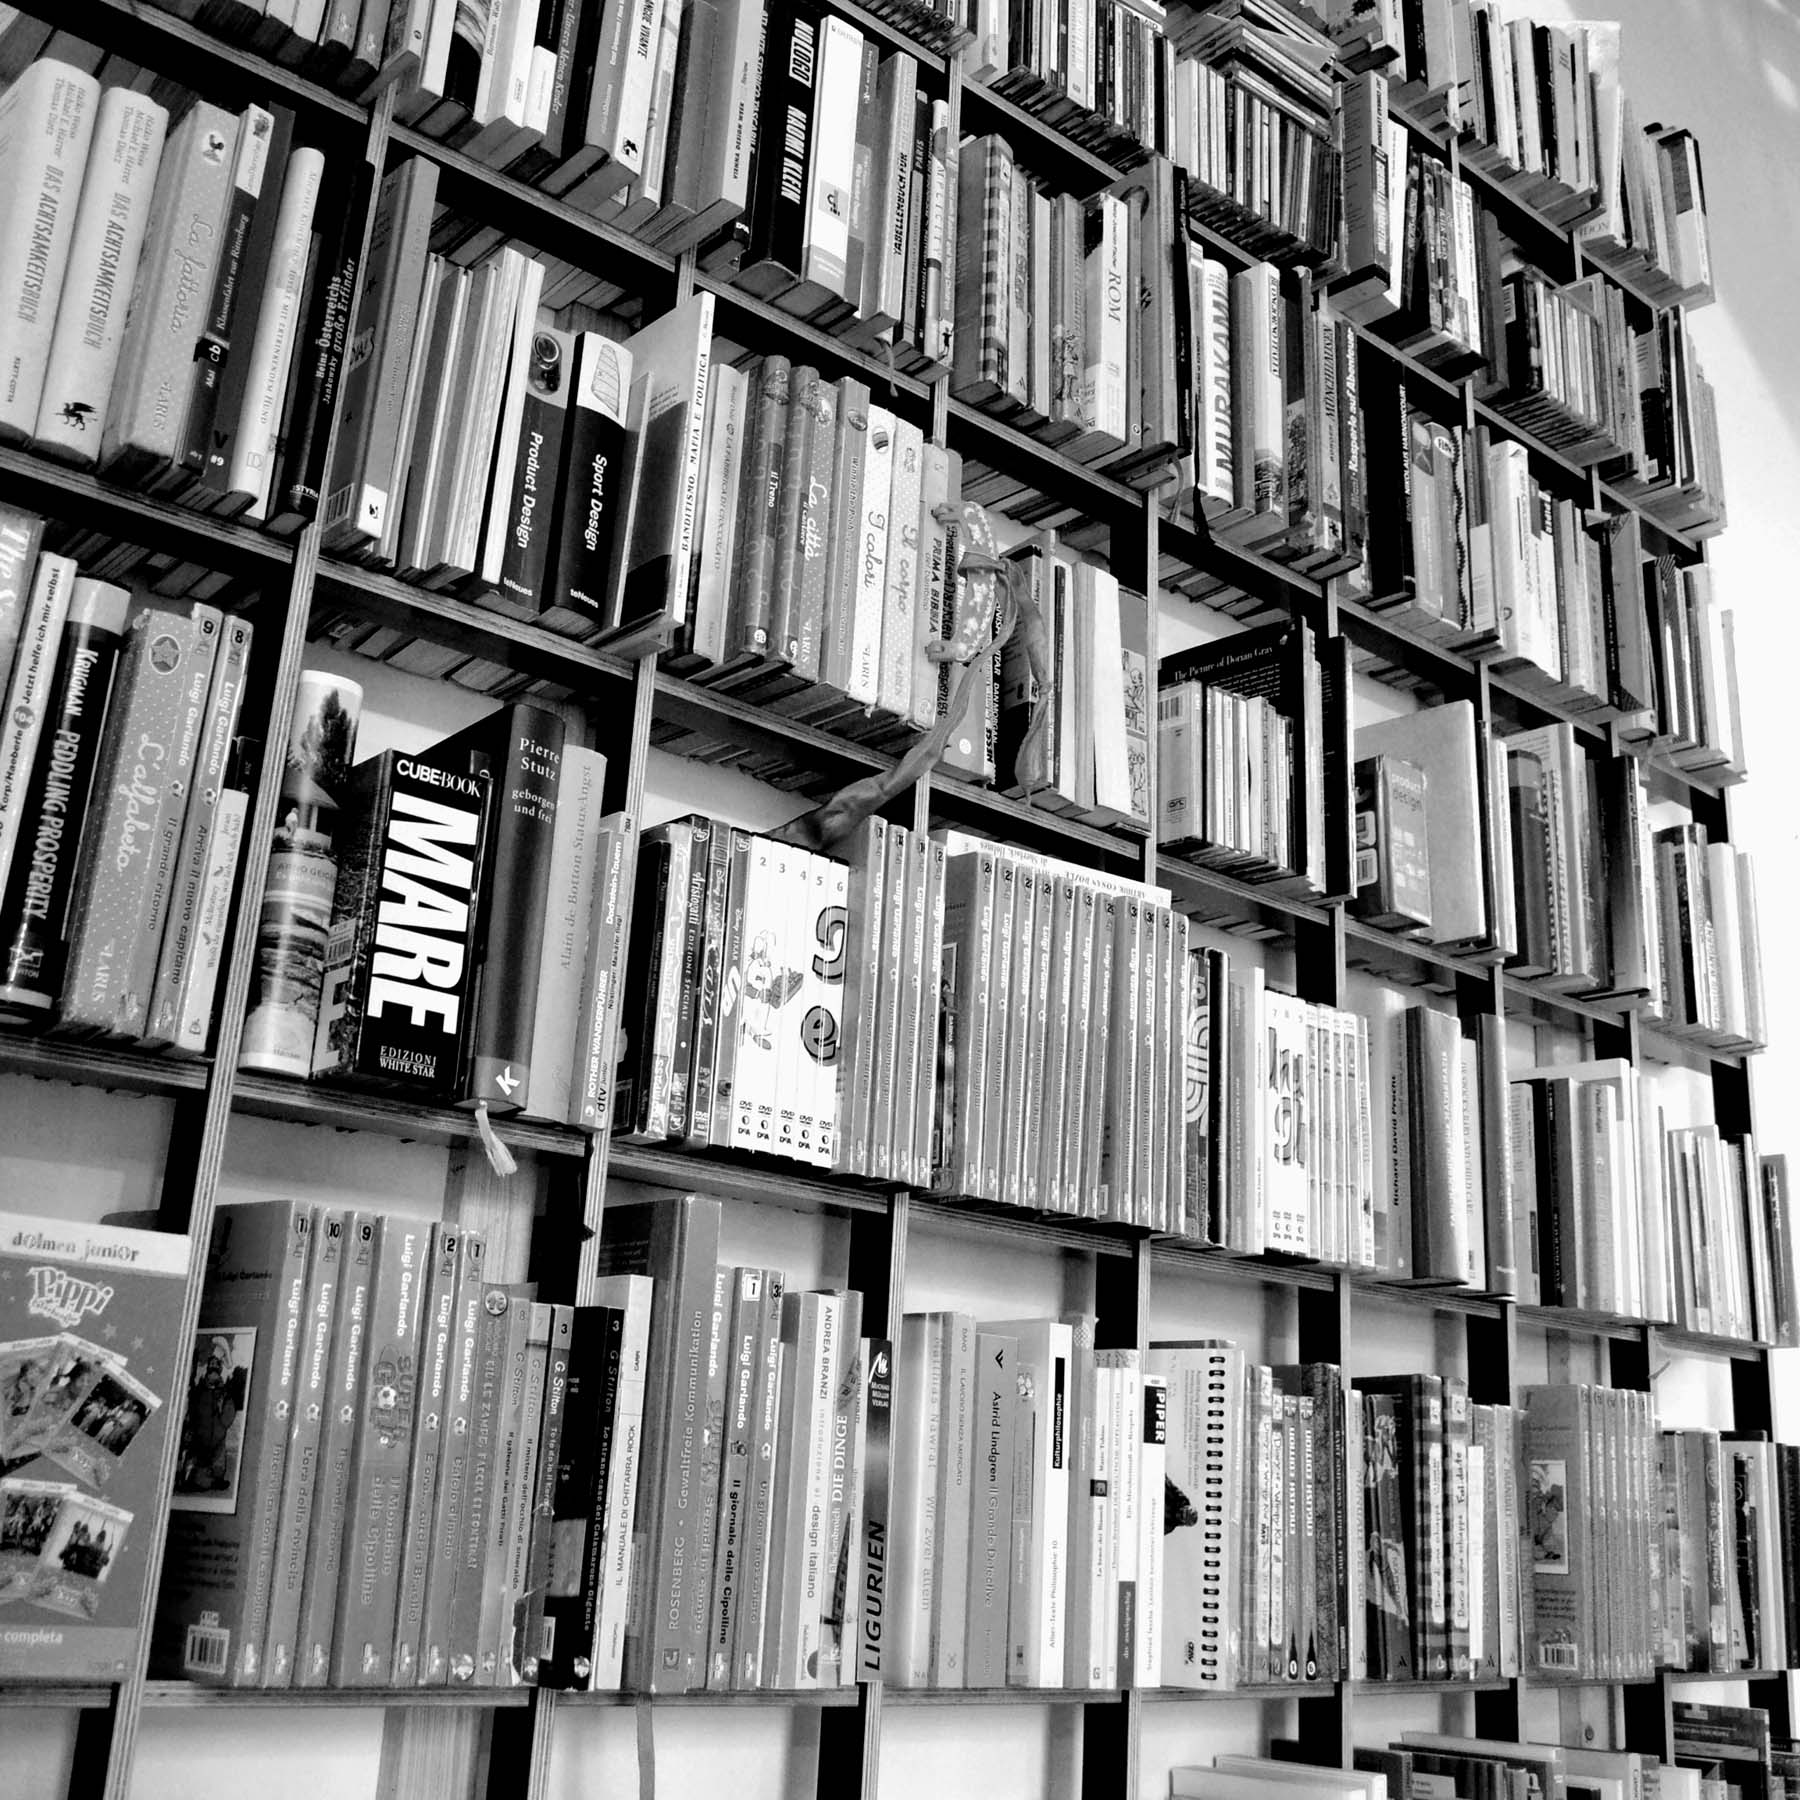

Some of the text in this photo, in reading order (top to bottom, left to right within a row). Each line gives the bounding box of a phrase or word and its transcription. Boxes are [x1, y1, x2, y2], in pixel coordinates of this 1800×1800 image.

[789, 18, 814, 88] NO LOGO
[781, 105, 807, 205] NAOMI KLEIN
[915, 140, 924, 171] PARIS
[894, 152, 908, 255] TABELLENBUCH FÜR
[18, 165, 64, 325] DAS ACHTSAMKEITSBUCH
[83, 192, 131, 350] DAS ACHTSAMKEITSBUCH
[169, 214, 214, 335] La fattoria
[216, 214, 249, 330] Klassenfahrt zur Ritterburg
[1108, 271, 1123, 322] ROM
[316, 274, 343, 378] Heinz Österreichs
[322, 256, 356, 404] Jankowsky große Erfinder
[1212, 289, 1232, 469] MURAKAMI
[1347, 326, 1358, 473] Kasperle auf Abenteuer
[682, 353, 707, 552] BANDITISMO, MAFIA E POLITICA
[1399, 384, 1412, 494] NIKOLAUS HARNONCOURT
[516, 431, 544, 549] Product Design
[585, 453, 608, 551] Sport Design
[768, 481, 778, 508] Treno
[804, 476, 828, 561] La città
[864, 532, 882, 588] colori
[891, 559, 910, 613] corpo
[929, 539, 942, 633] PRIMA BIBBIA
[22, 568, 60, 704] Jetzt helfe ich mir selbst
[203, 619, 214, 637] 9
[234, 628, 245, 646] 8
[1174, 669, 1187, 681] The
[1188, 662, 1215, 677] Picture
[1254, 645, 1274, 662] Gray
[217, 680, 235, 720] Luigi
[208, 722, 229, 775] Garlando
[519, 737, 561, 763] Pierre
[520, 757, 557, 781] Stutz
[26, 649, 98, 920] KRUGMAN PEDDLING PROSPERITY
[117, 733, 165, 873] L'alfabeto
[512, 787, 556, 810] geborgen
[513, 803, 553, 824] und frei
[190, 824, 208, 865] Arriva
[759, 856, 767, 867] 2
[778, 863, 785, 874] 3
[605, 840, 622, 926] Dachstein-Tauern
[800, 870, 807, 881] 4
[816, 875, 823, 886] 5
[837, 881, 843, 892] 6
[180, 879, 196, 923] nuovo
[366, 790, 479, 1035] MARE
[171, 925, 191, 986] capitano
[679, 871, 706, 1020] Aristogatti EDIZIONE SPECIALE
[380, 1045, 437, 1066] EDIZIONI
[587, 969, 610, 1099] ROTHER WANDERFÜHRER
[379, 1056, 436, 1078] WHITE STAR
[327, 1221, 341, 1239] 10
[362, 1225, 371, 1242] 9
[446, 1236, 456, 1252] 2
[473, 1243, 481, 1259] 1
[27, 1266, 114, 1317] Pippi
[319, 1283, 333, 1318] Luigi
[397, 1233, 416, 1337] Luigi Garlando
[750, 1282, 757, 1297] 1
[560, 1323, 568, 1335] 3
[612, 1319, 620, 1332] 3
[823, 1306, 833, 1353] ANDREA
[310, 1321, 328, 1389] Garlando
[609, 1349, 619, 1359] G
[819, 1355, 830, 1400] BRANZI
[603, 1366, 617, 1413] Stilton
[990, 1391, 1001, 1427] Astrid
[928, 1412, 938, 1469] Nawrat
[1053, 1392, 1063, 1468] Kulturphilosophie
[1155, 1392, 1166, 1442] PIPER
[598, 1442, 609, 1475] strano
[669, 1310, 703, 1631] ROSENBERG Gewaltfreie Kommunikation
[988, 1429, 1000, 1483] Lindgren
[595, 1504, 603, 1520] del
[596, 1478, 605, 1501] caso
[616, 1424, 636, 1586] IL MANUALE DI CHITARRA ROCK
[718, 1335, 753, 1645] Luigi Garlando Il giornale delle Cipolline
[927, 1495, 936, 1522] Wir
[809, 1504, 821, 1547] design
[924, 1527, 934, 1562] zwei
[588, 1523, 600, 1586] Calamarone
[807, 1550, 819, 1599] italiano
[583, 1589, 594, 1631] Gigante
[865, 1520, 885, 1671] LIGURIEN
[920, 1565, 932, 1612] allein
[4, 1630, 63, 1645] completa
